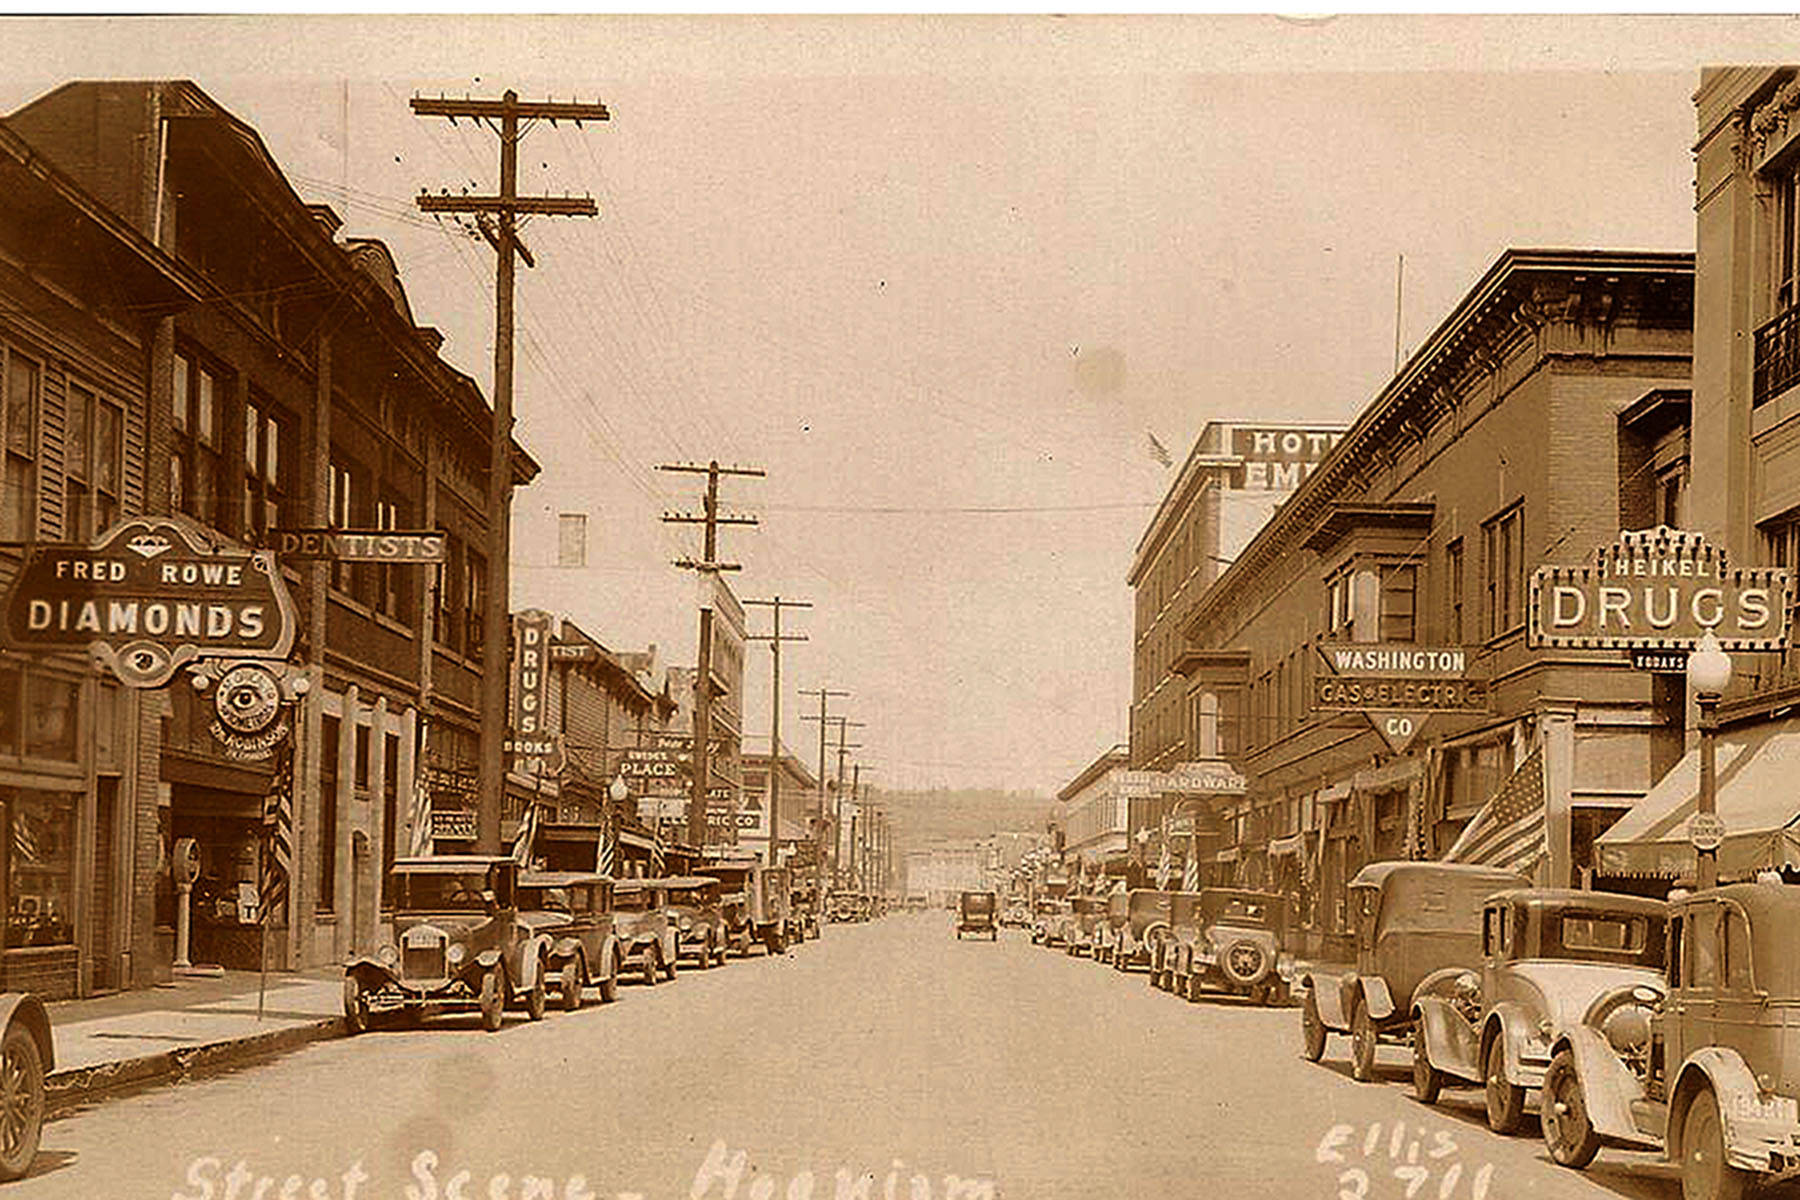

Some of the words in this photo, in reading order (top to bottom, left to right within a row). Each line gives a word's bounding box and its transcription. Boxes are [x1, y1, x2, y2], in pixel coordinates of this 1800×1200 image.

[281, 531, 442, 558] DENTISTS
[56, 560, 127, 583] FRED
[161, 563, 243, 587] ROWE
[1614, 559, 1711, 578] HEIKEL
[1552, 586, 1772, 629] DRUGS
[28, 599, 266, 639] DIAMONDS
[1335, 650, 1466, 672] WASHINGTON
[521, 627, 540, 733] DRUGS
[1386, 717, 1413, 736] CO
[503, 740, 553, 754] BOOKS
[620, 762, 677, 776] PLACE
[735, 815, 754, 827] CO
